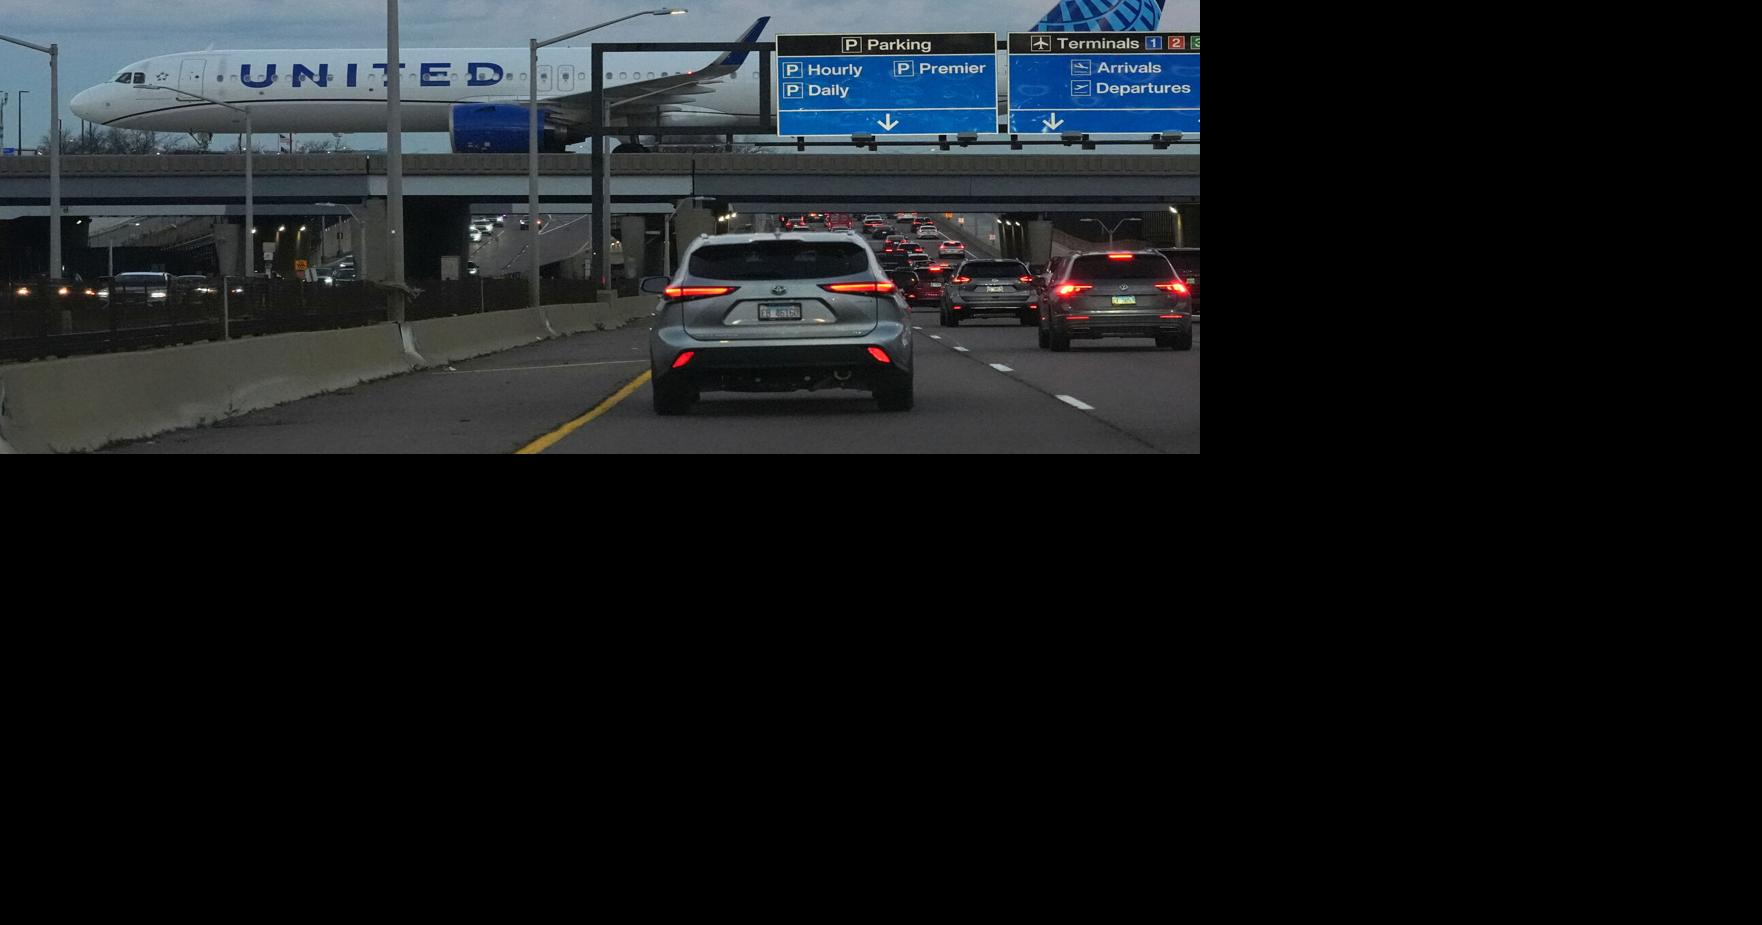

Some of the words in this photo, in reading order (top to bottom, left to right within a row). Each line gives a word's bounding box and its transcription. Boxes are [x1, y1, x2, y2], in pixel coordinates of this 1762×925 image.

[845, 39, 858, 51] P
[867, 39, 932, 53] Parking
[1057, 37, 1140, 49] Terminals
[1172, 38, 1181, 48] 2
[240, 62, 504, 88] UNITED
[786, 64, 799, 76] P
[808, 64, 863, 78] Hourly
[897, 62, 910, 75] P
[919, 62, 986, 74] Premier
[1097, 62, 1162, 74] Arrivals
[786, 84, 799, 96] P
[808, 84, 849, 98] Daily
[1096, 82, 1191, 96] Departures
